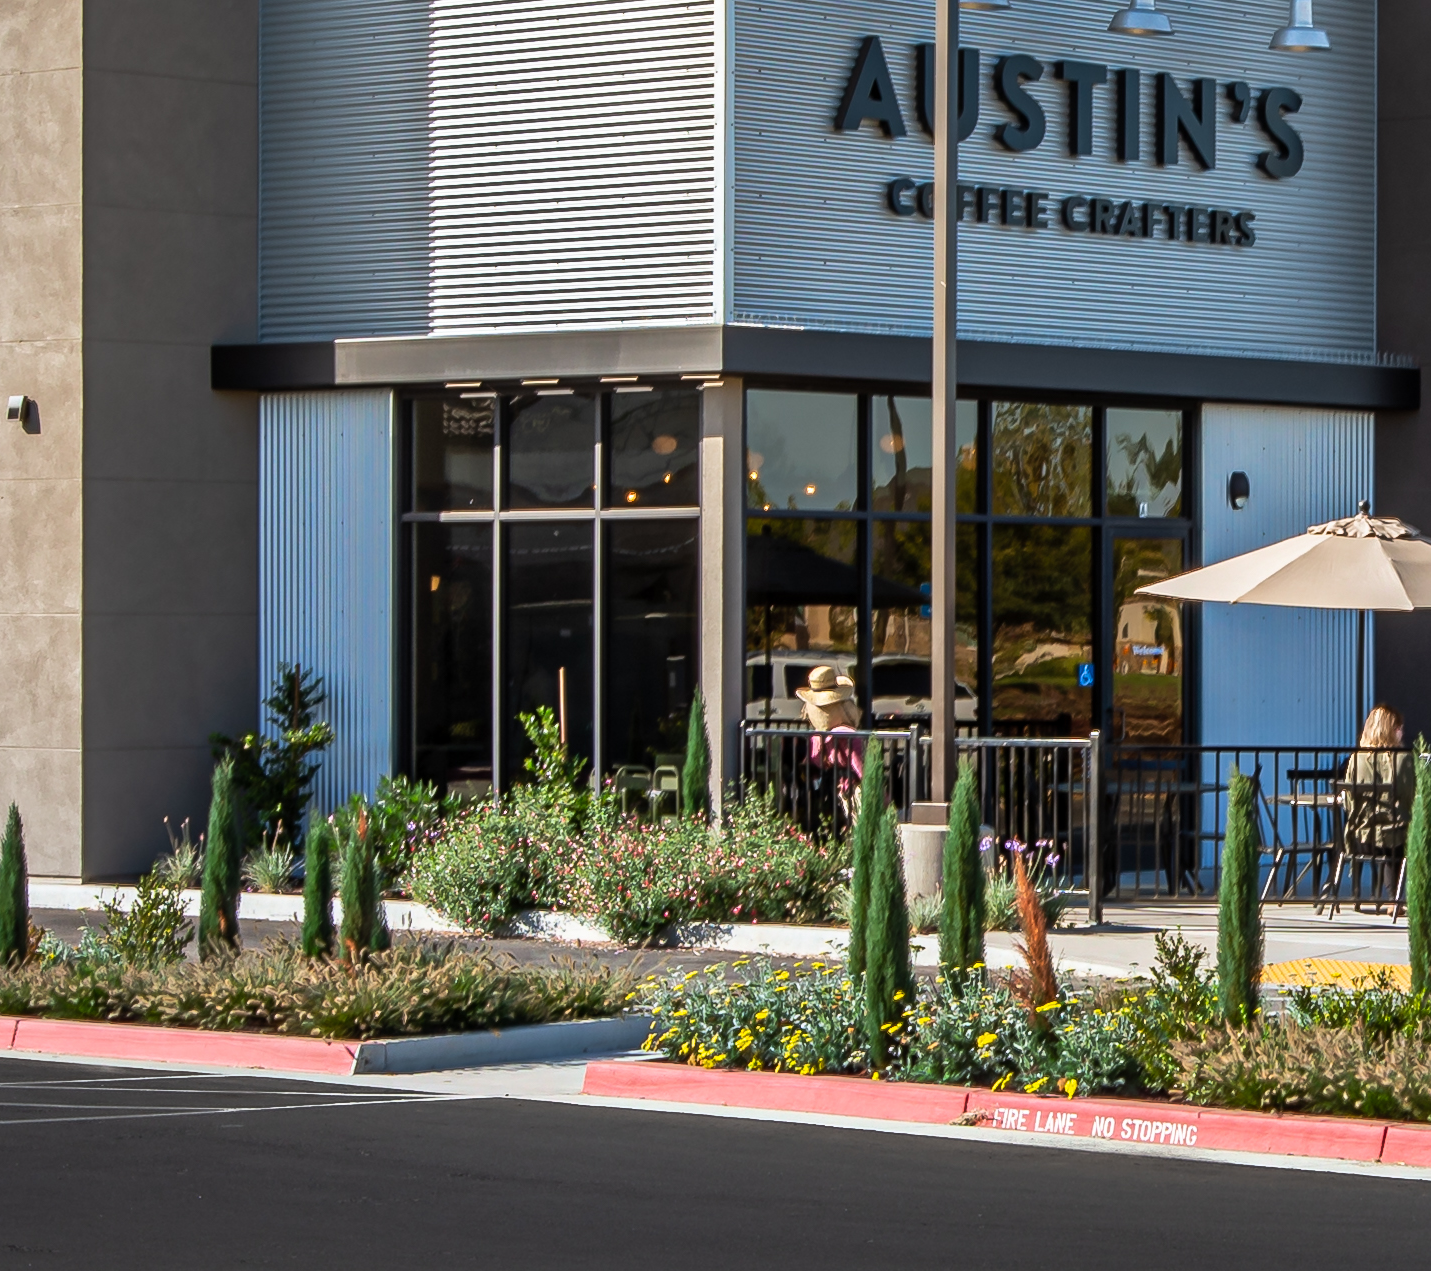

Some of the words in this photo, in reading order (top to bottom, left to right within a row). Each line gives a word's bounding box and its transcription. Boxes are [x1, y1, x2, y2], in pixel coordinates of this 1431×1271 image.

[833, 34, 1305, 179] AUSTIN'S
[1061, 195, 1257, 247] CRAFTERS
[993, 1107, 1030, 1131] FIRE
[1034, 1110, 1079, 1135] LANE
[1091, 1115, 1116, 1139] NO
[1120, 1118, 1198, 1146] STOPPING
